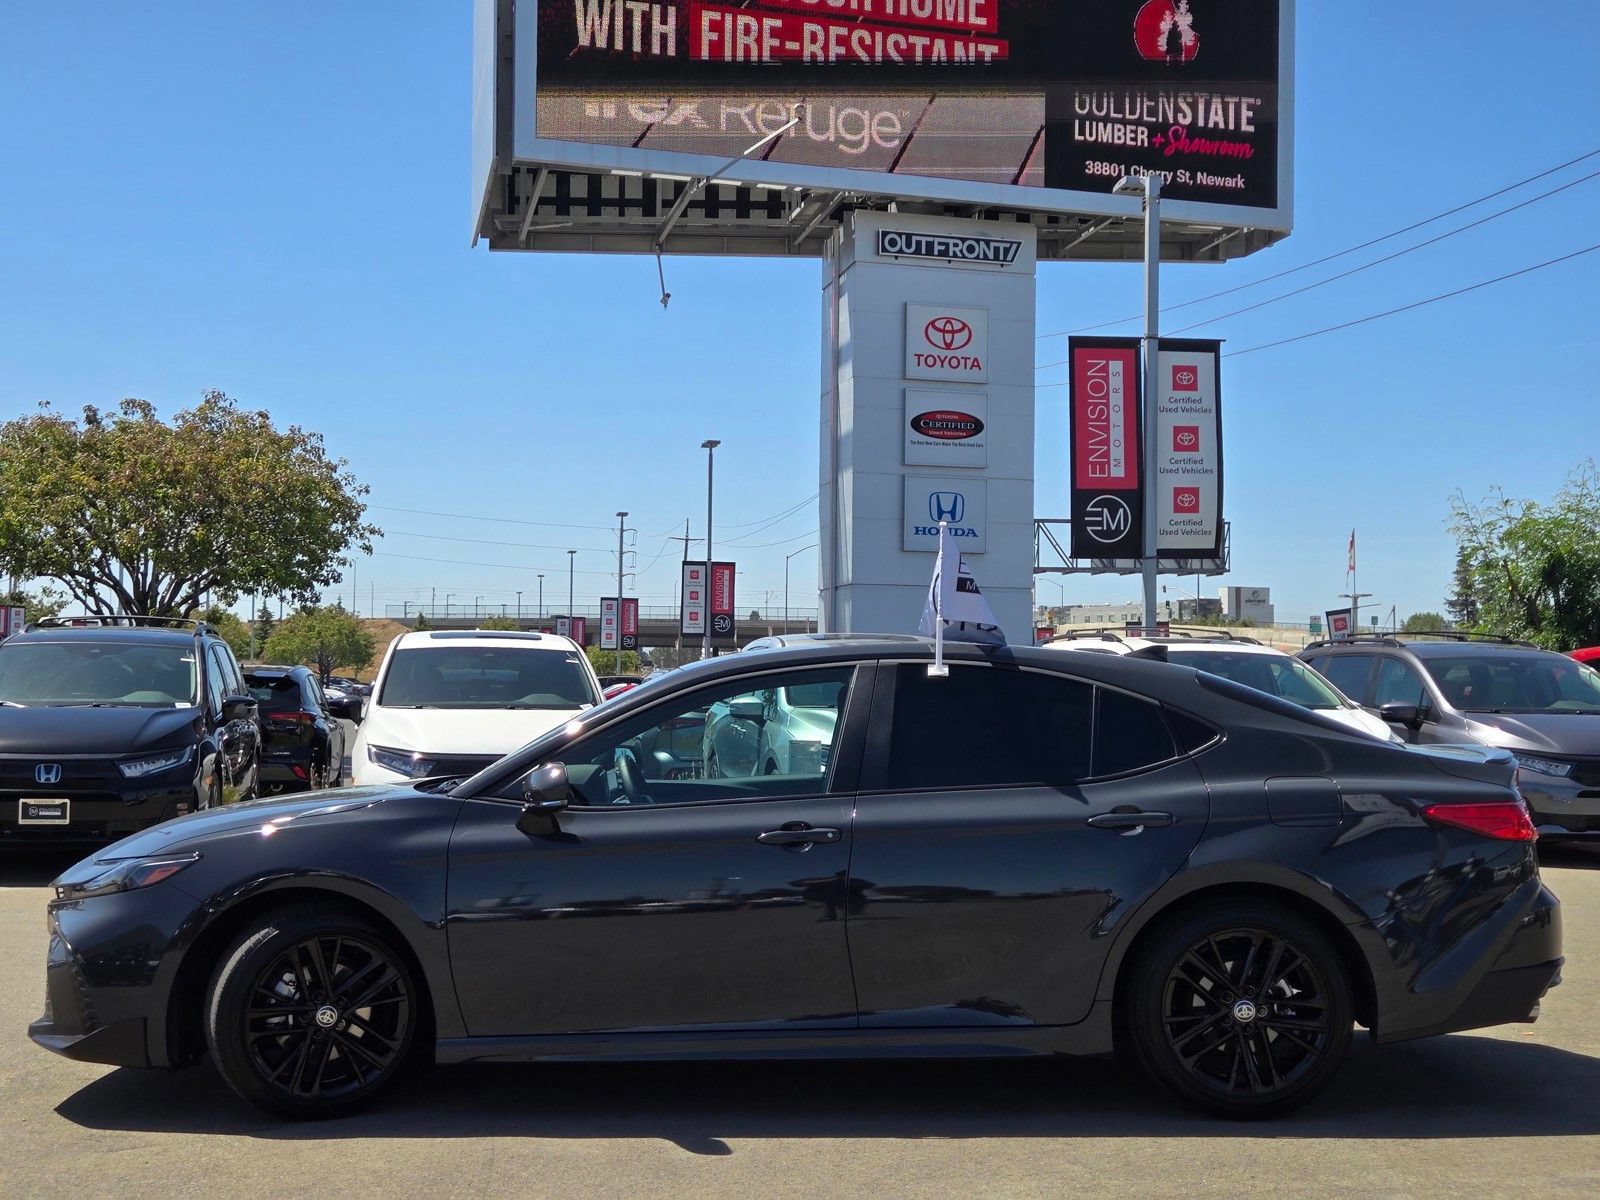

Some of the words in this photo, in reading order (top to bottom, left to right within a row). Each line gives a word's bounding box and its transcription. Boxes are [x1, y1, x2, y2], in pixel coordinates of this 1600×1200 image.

[576, 0, 677, 56] WITH
[1074, 119, 1149, 147] LUMBER
[1164, 125, 1255, 159] Showroom
[1085, 160, 1126, 177] 38801
[1176, 169, 1193, 185] St,
[1197, 172, 1245, 188] Newark
[914, 353, 982, 371] TOYOTA
[1168, 396, 1202, 404] Certified
[920, 419, 975, 430] CERTIFIED
[1087, 359, 1108, 477] ENVISION
[1112, 371, 1122, 468] MOTORS
[1169, 457, 1203, 465] Certified
[914, 526, 979, 538] HODA
